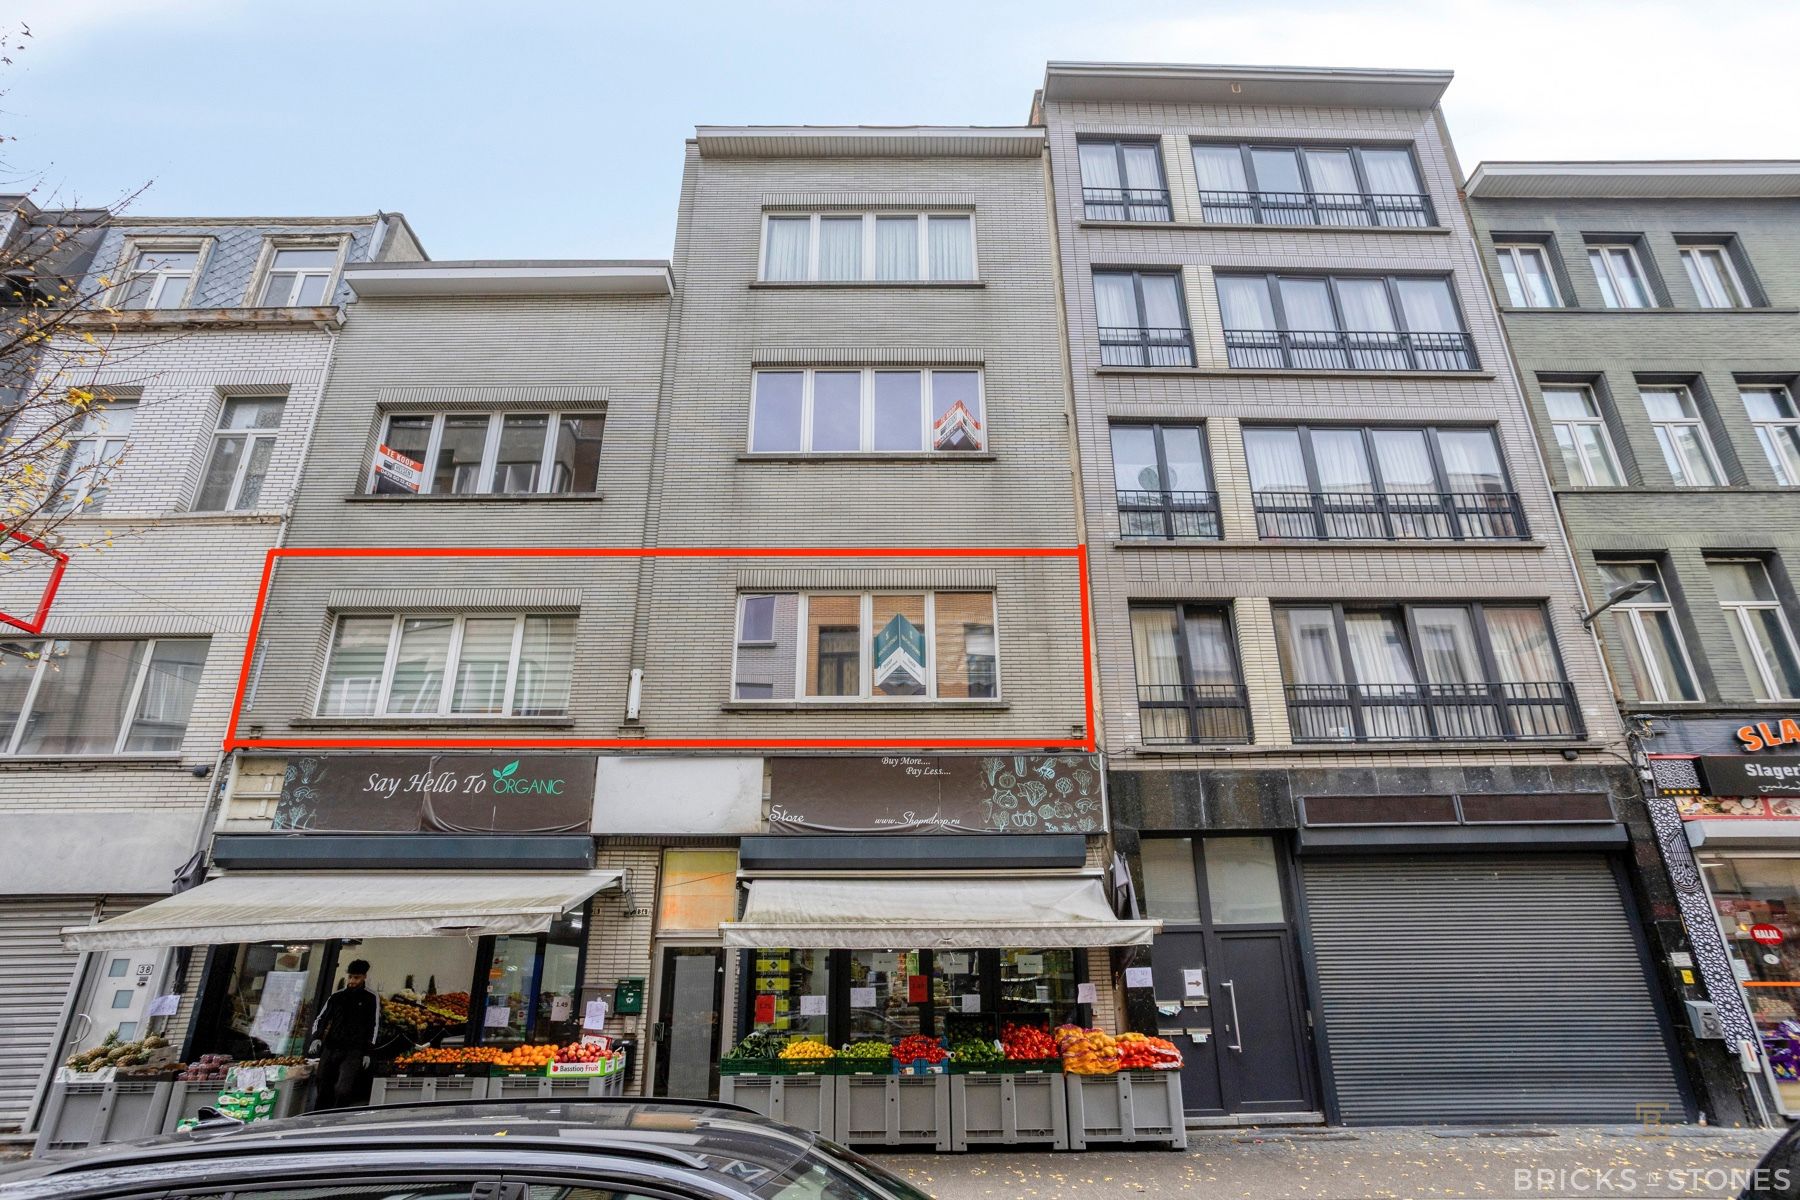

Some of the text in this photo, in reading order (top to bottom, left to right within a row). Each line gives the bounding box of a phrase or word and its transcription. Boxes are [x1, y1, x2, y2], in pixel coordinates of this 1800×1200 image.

[387, 449, 395, 457] TE
[396, 455, 415, 467] KOOP
[1737, 719, 1800, 751] SLA
[881, 757, 898, 767] Buy
[905, 767, 922, 777] Pay
[363, 771, 565, 799] Say Hello To ORGANIC
[769, 805, 804, 822] Store
[1754, 930, 1780, 939] HALAL
[139, 965, 151, 974] 38
